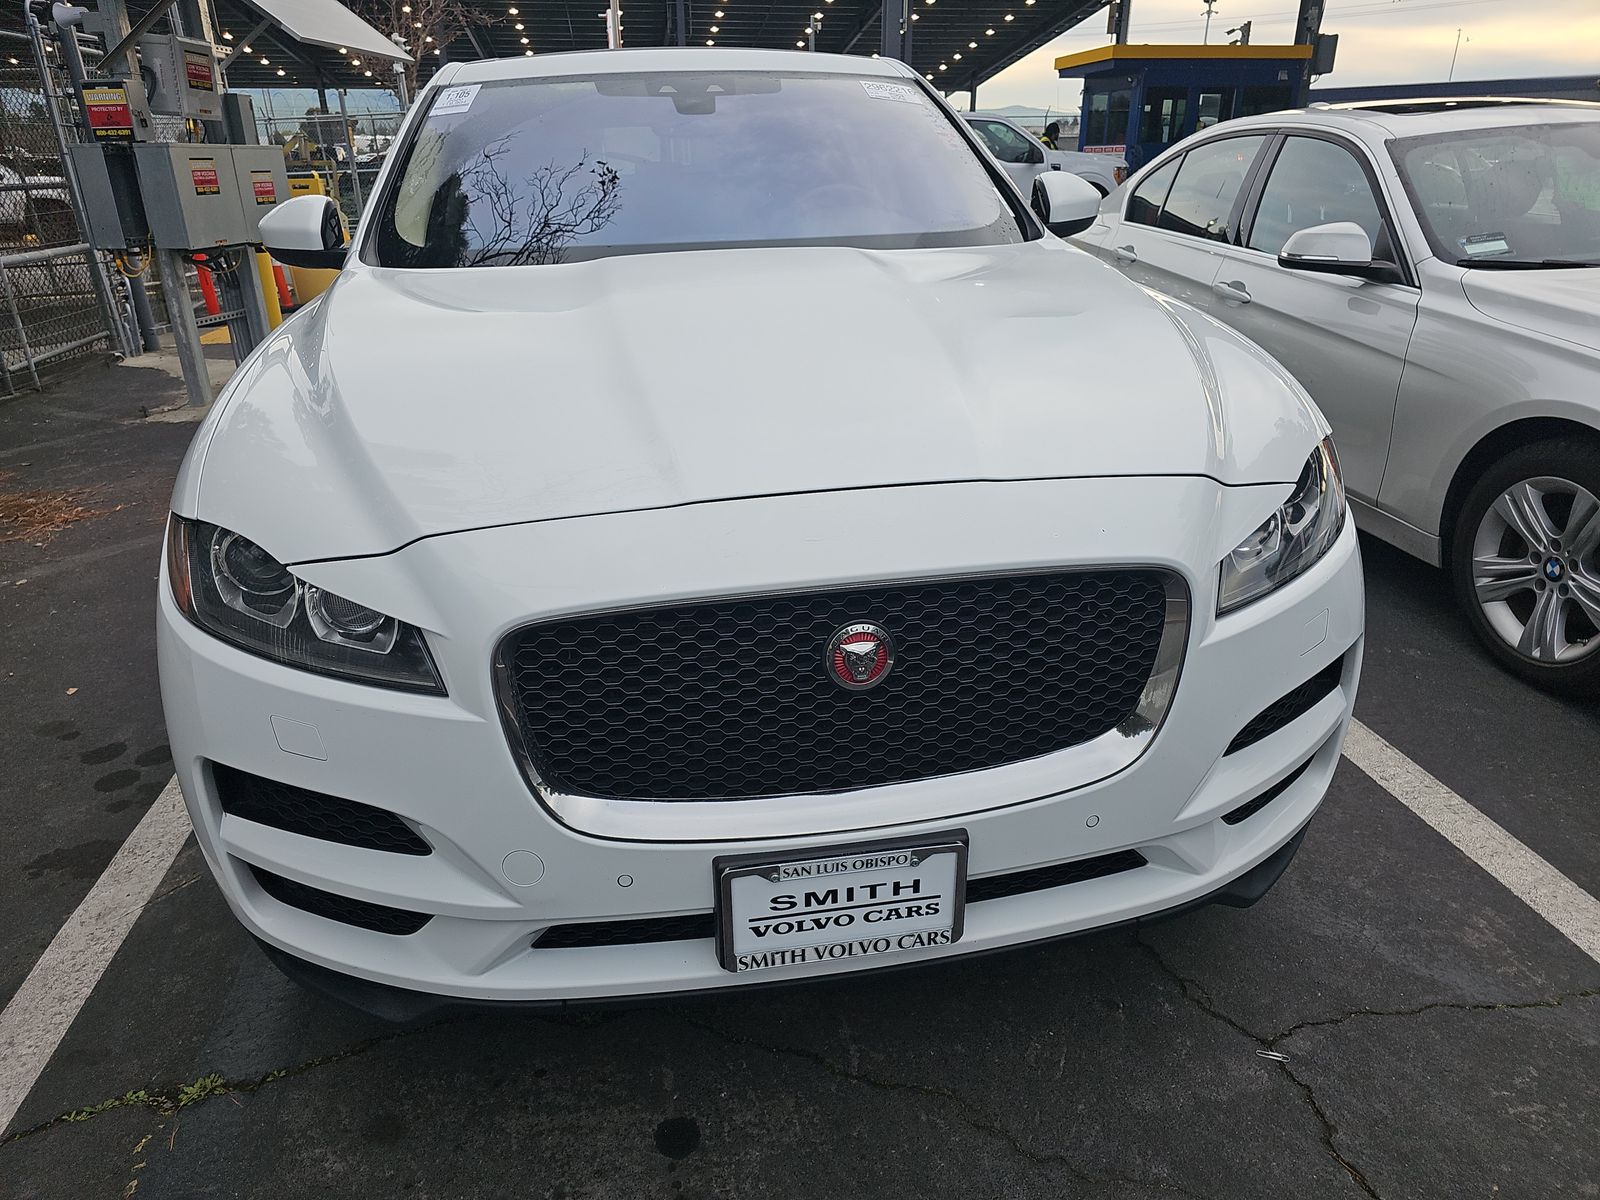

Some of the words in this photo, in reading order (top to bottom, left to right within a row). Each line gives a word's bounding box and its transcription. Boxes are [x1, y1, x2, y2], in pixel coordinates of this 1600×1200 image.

[832, 624, 889, 648] JAGUAR
[782, 864, 812, 879] SAN
[816, 861, 848, 874] LUIS
[852, 854, 909, 870] OBISPO
[768, 878, 921, 912] SMITH
[748, 913, 855, 938] VOLVO
[863, 902, 941, 923] CARS
[738, 948, 806, 971] SMITH
[814, 938, 891, 961] VOLVO
[897, 929, 951, 950] CARS
